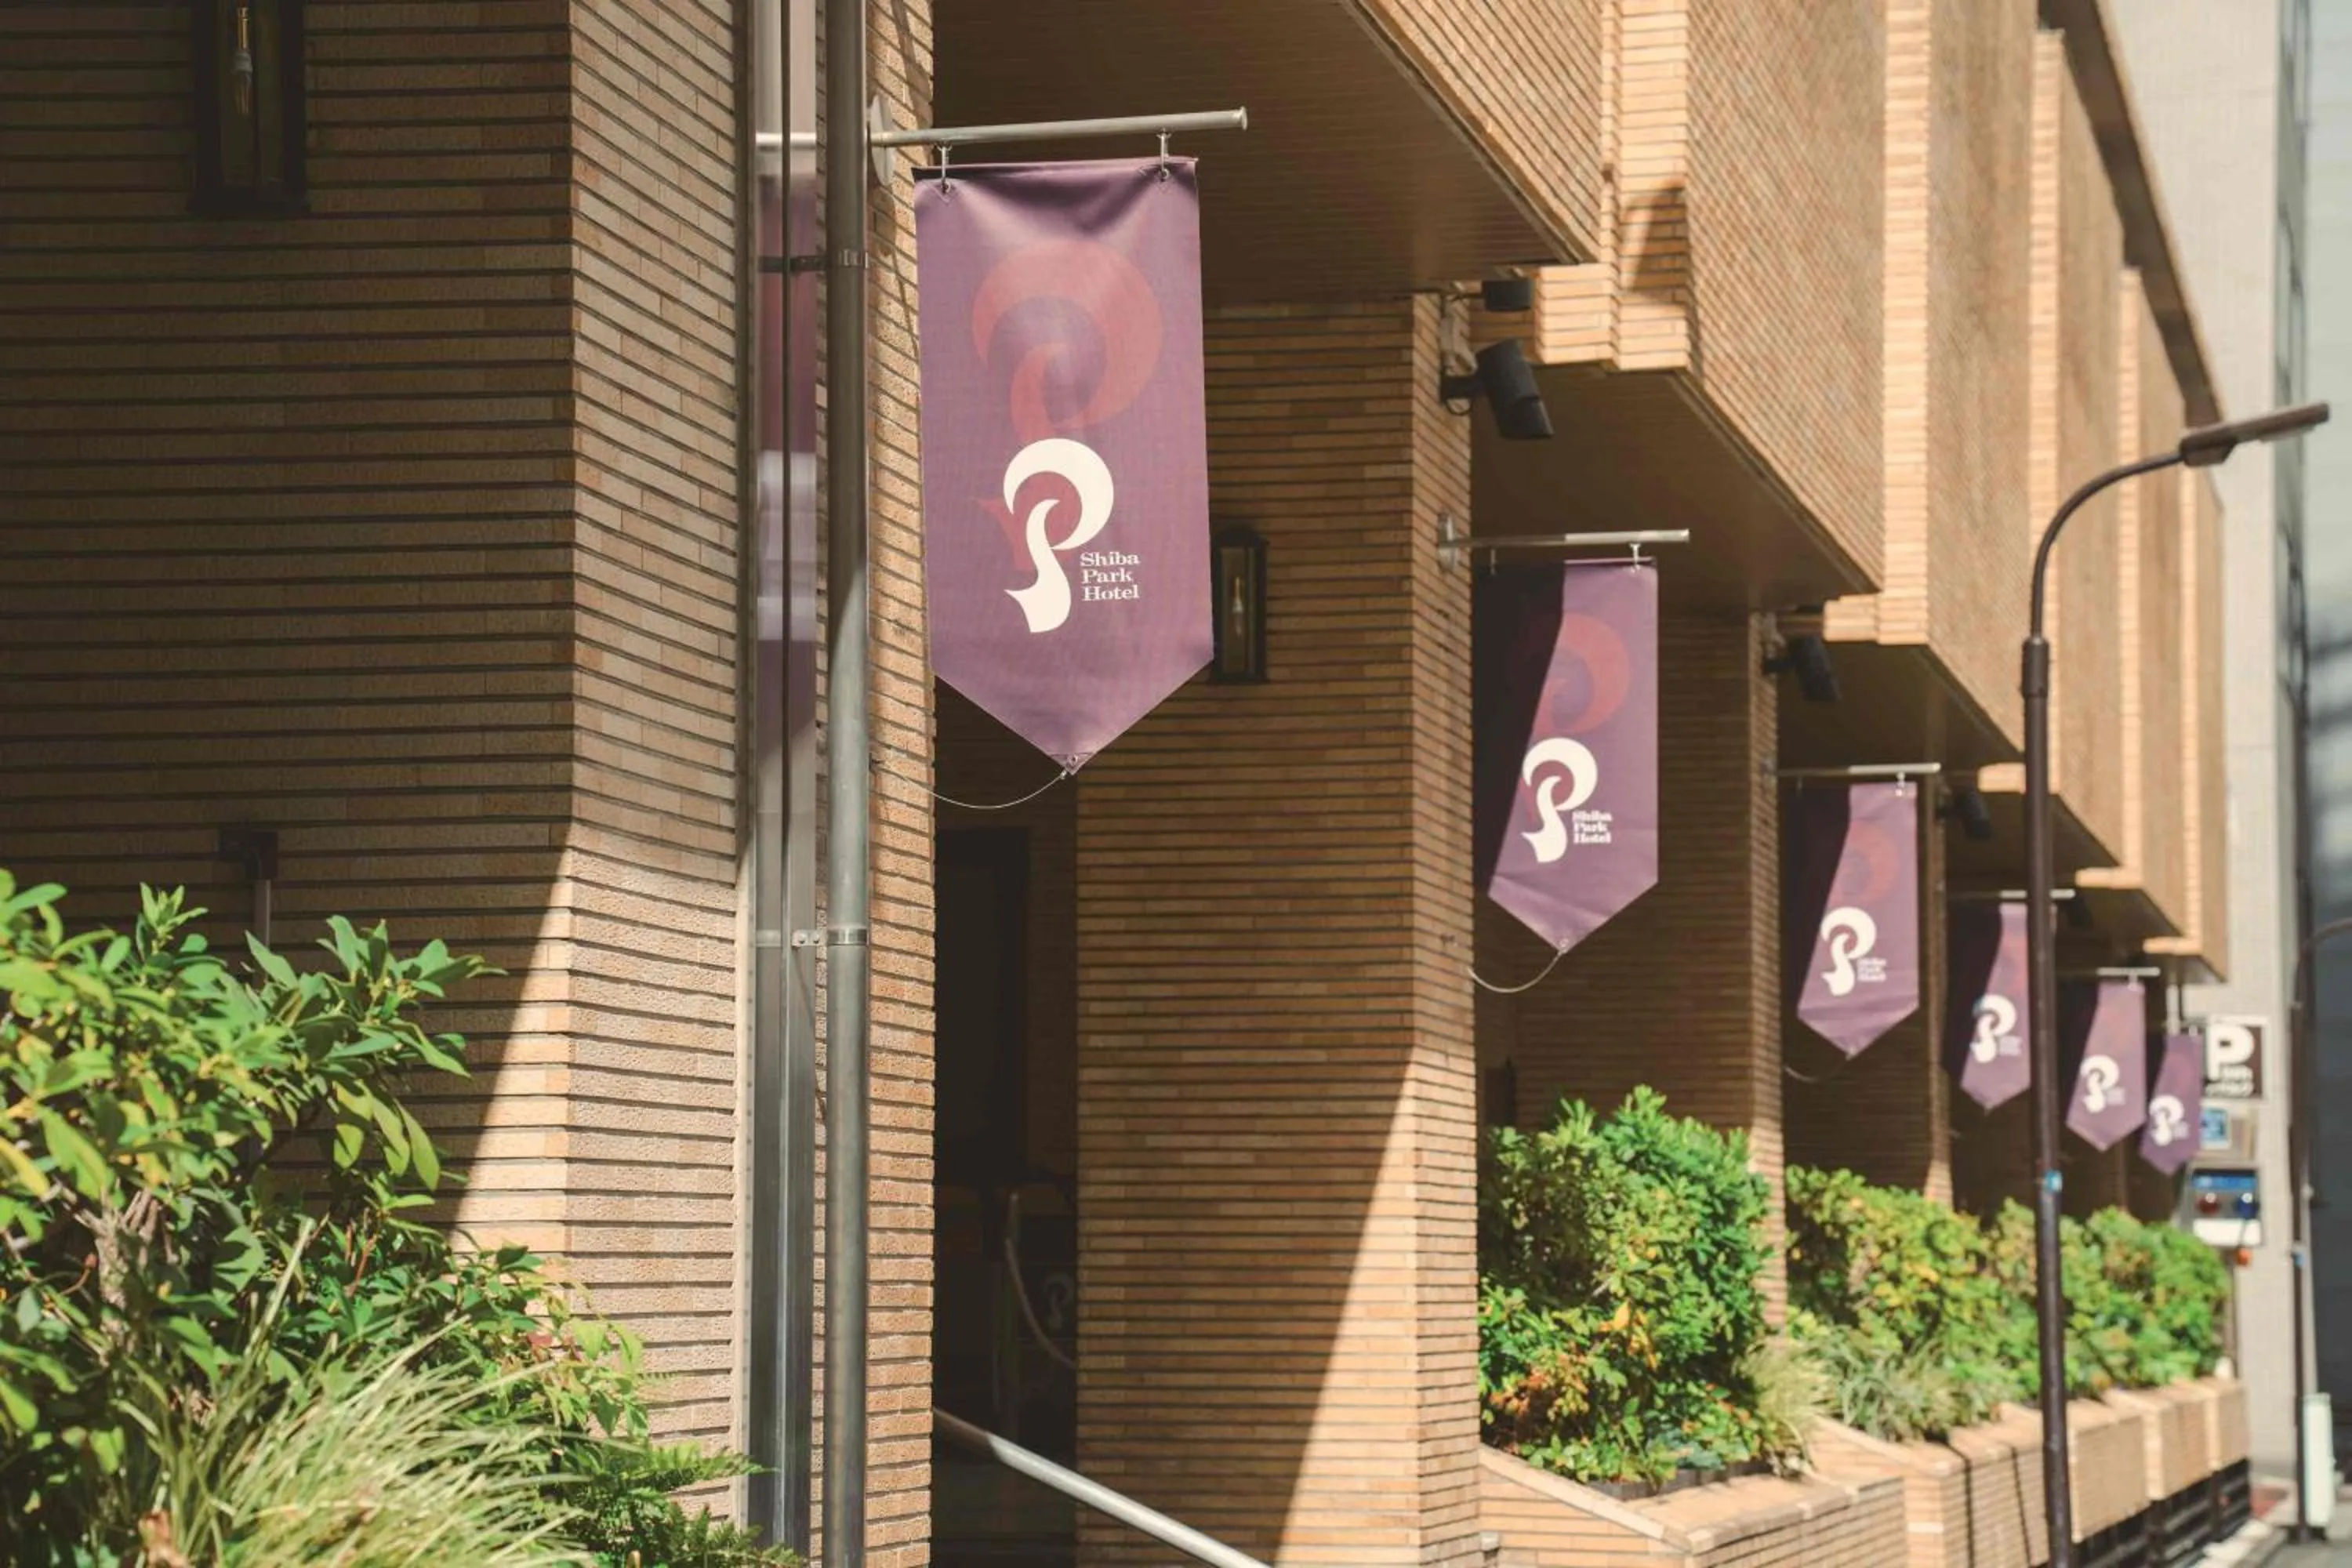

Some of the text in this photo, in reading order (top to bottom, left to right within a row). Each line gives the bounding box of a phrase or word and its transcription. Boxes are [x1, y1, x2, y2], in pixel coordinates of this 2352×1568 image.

[1080, 551, 1141, 567] Shiba
[1081, 568, 1134, 584] Park
[1082, 584, 1139, 601] Hotel
[2207, 1022, 2255, 1080] P
